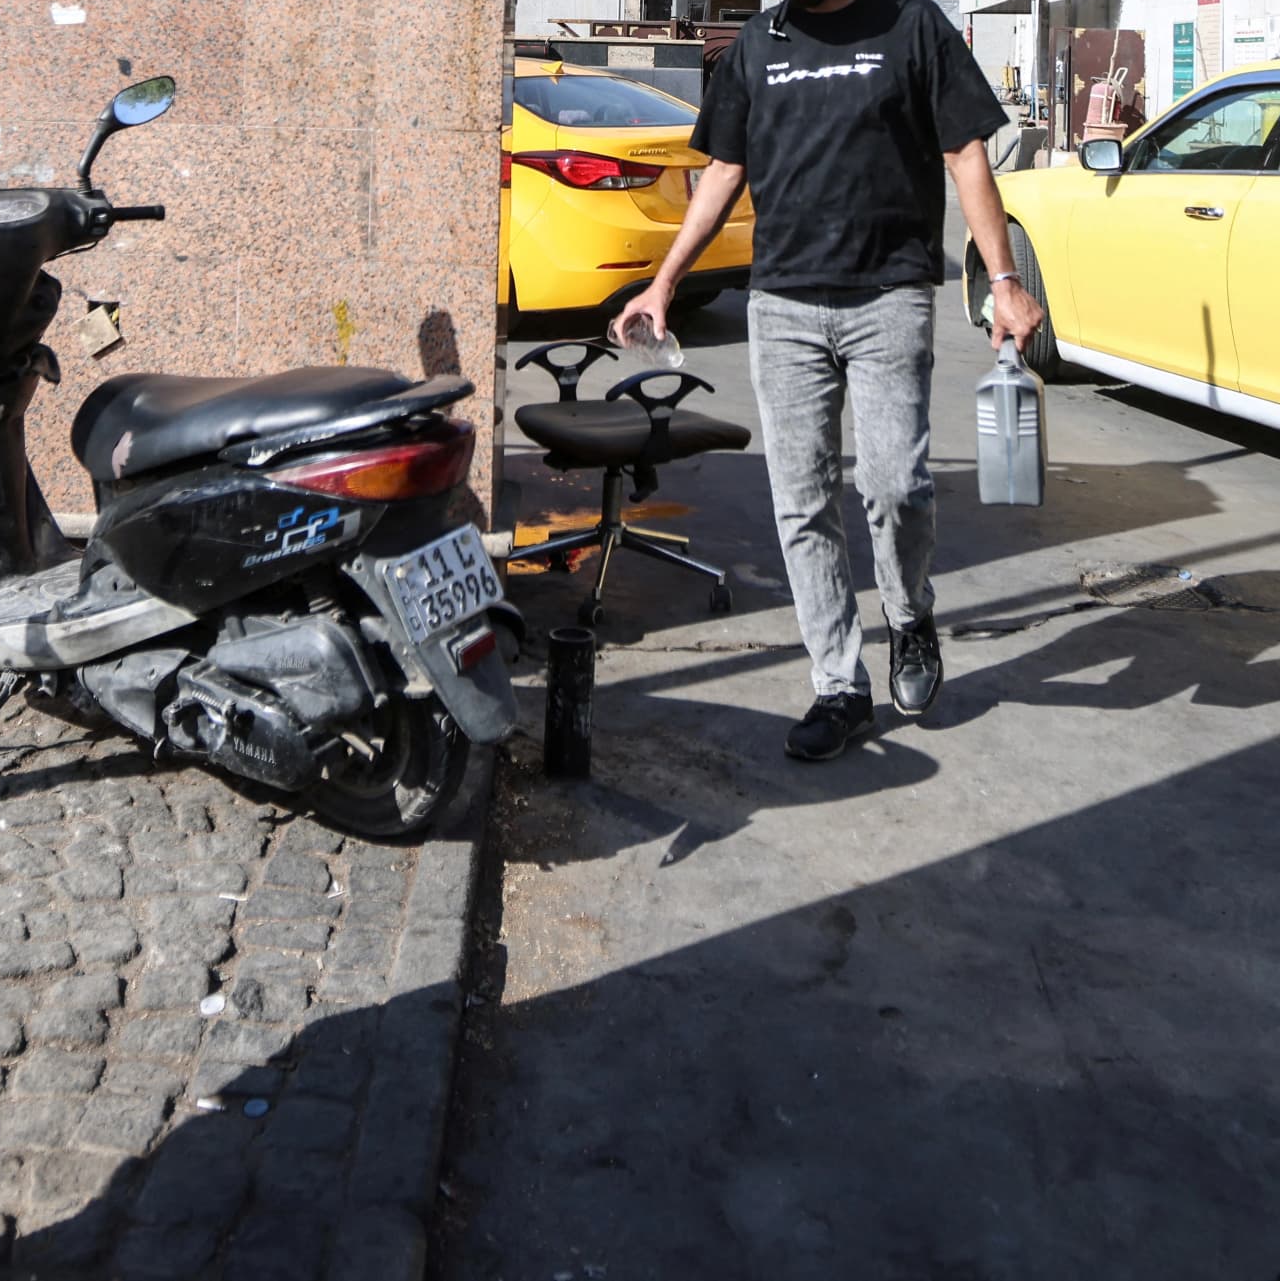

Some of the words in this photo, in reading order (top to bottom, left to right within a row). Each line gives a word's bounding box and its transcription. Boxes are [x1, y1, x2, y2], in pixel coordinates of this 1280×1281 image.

[418, 546, 455, 590] 11
[420, 566, 498, 630] 35996
[232, 736, 276, 765] YAMAHA
